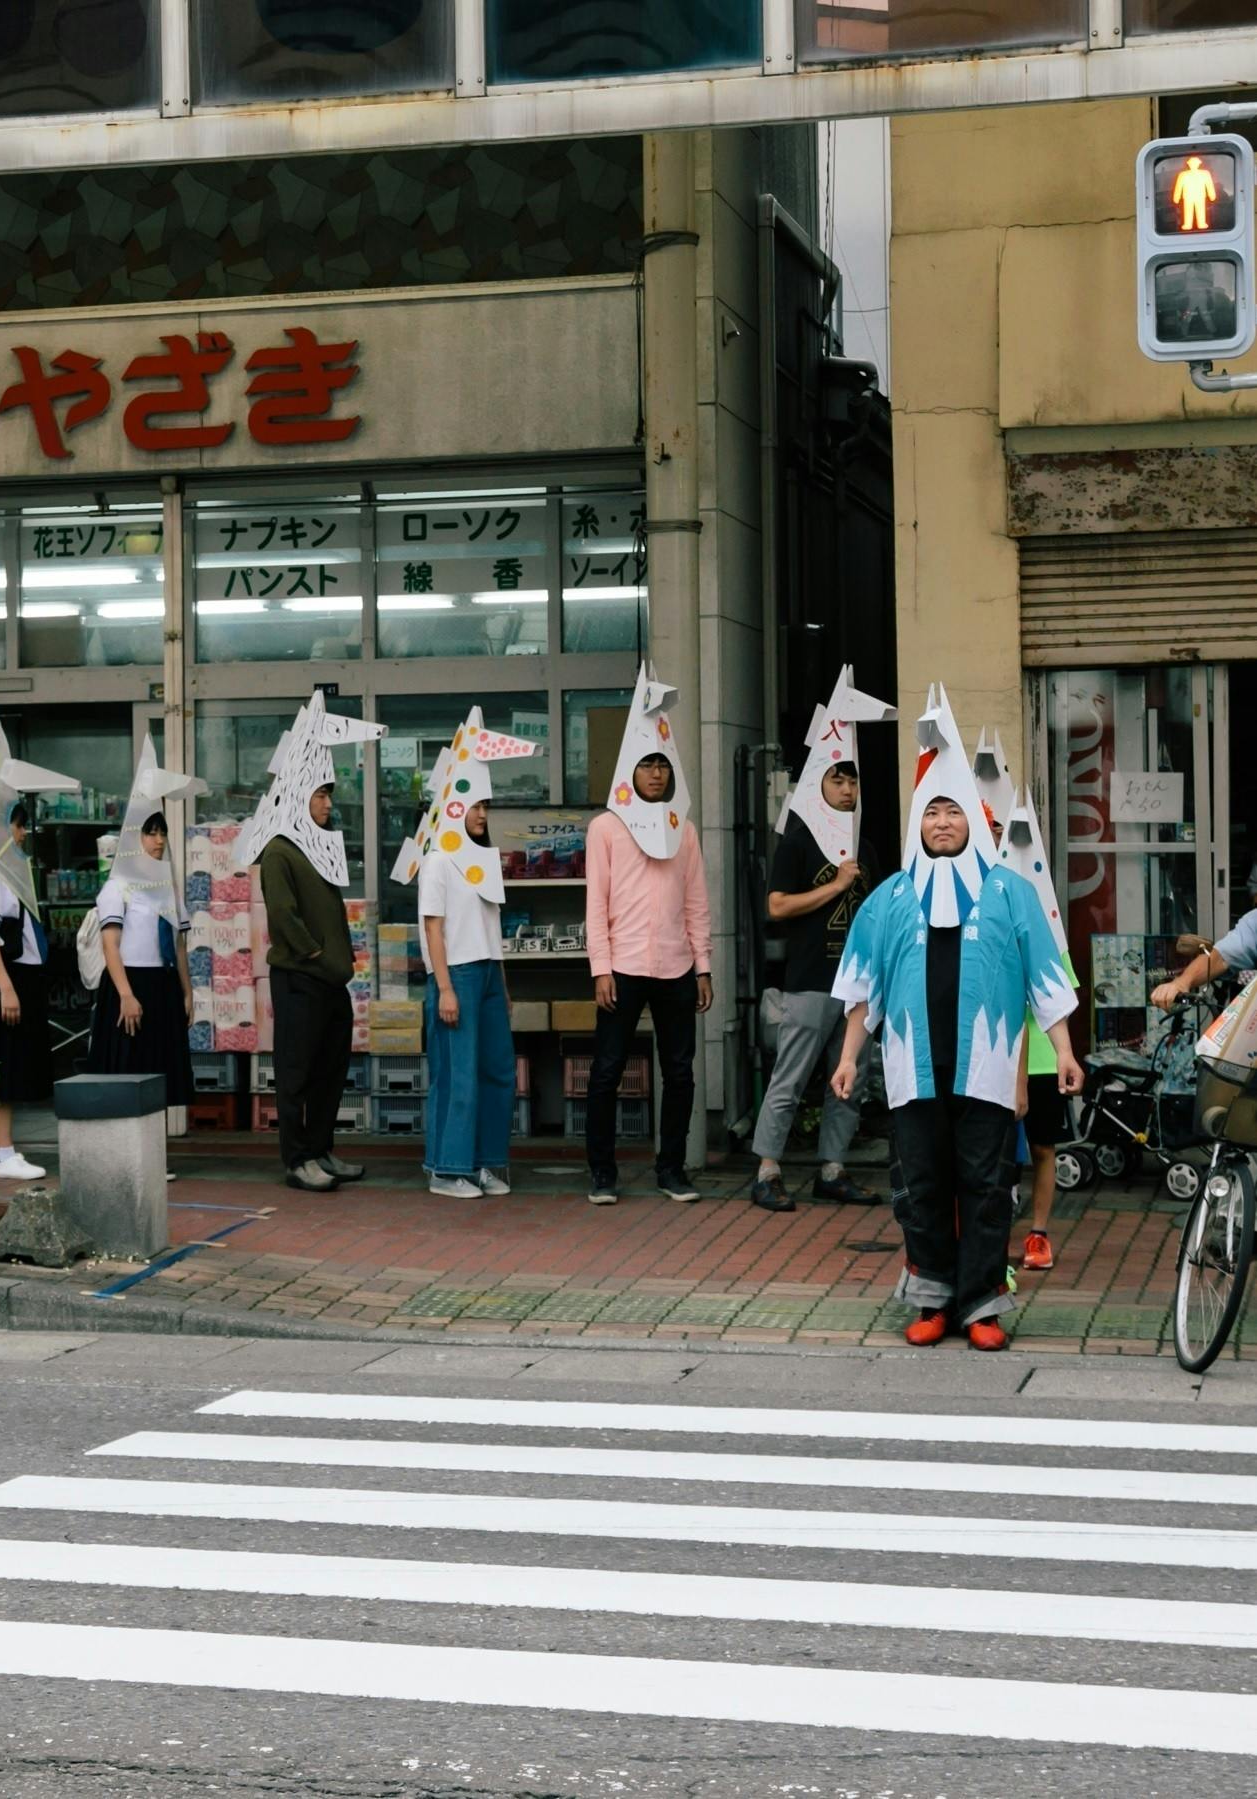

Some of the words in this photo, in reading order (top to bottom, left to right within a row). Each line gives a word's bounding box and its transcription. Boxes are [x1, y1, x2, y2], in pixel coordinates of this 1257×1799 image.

[219, 516, 337, 550] ナプキン
[403, 508, 521, 541] ローソク
[224, 564, 338, 597] パンスト
[528, 823, 577, 834] エコ・アイス
